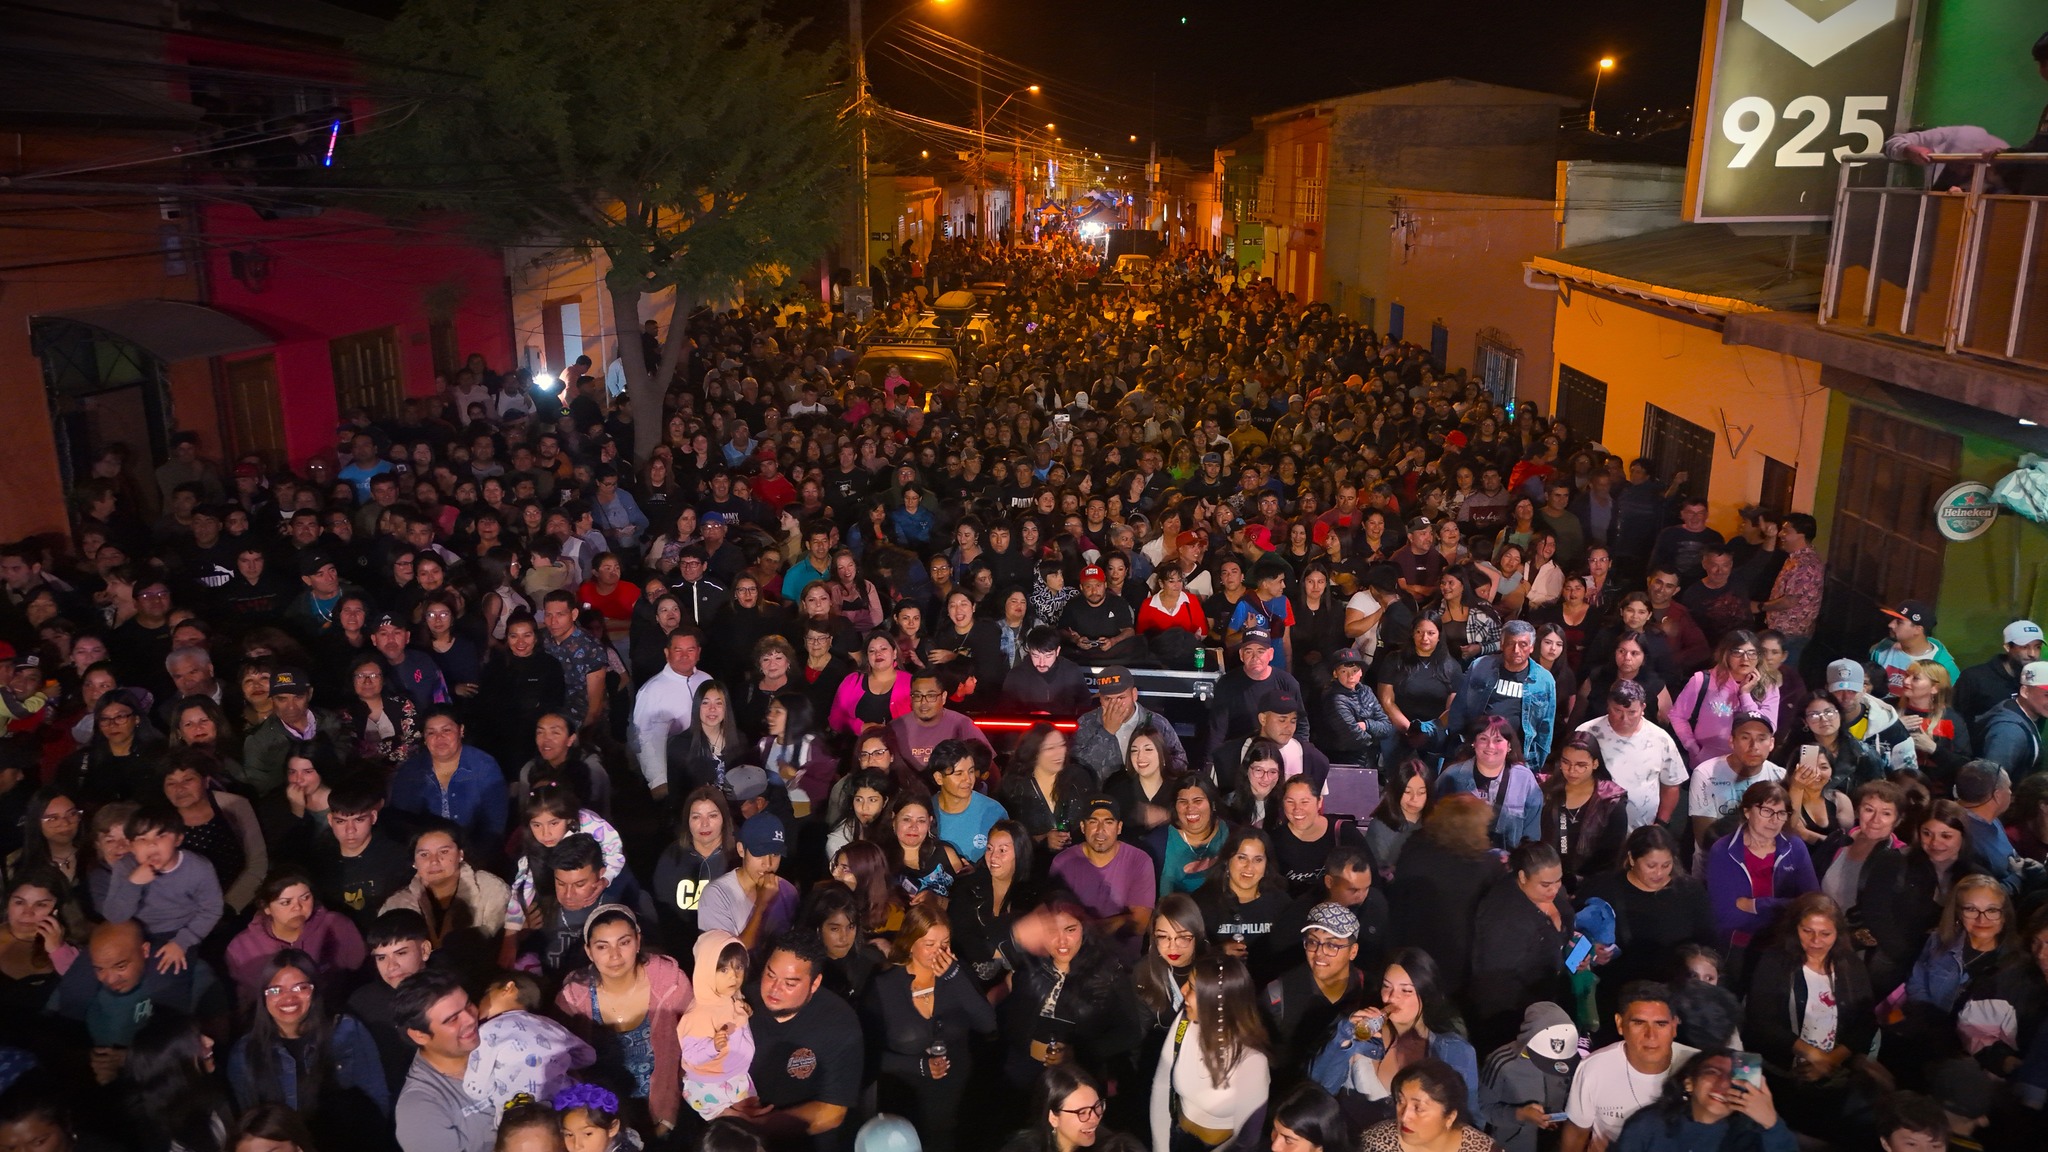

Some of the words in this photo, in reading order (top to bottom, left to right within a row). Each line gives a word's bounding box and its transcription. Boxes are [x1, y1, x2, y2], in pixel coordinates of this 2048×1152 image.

[1722, 95, 1888, 169] 925
[1944, 508, 1992, 518] Heineken
[1493, 678, 1524, 699] UM
